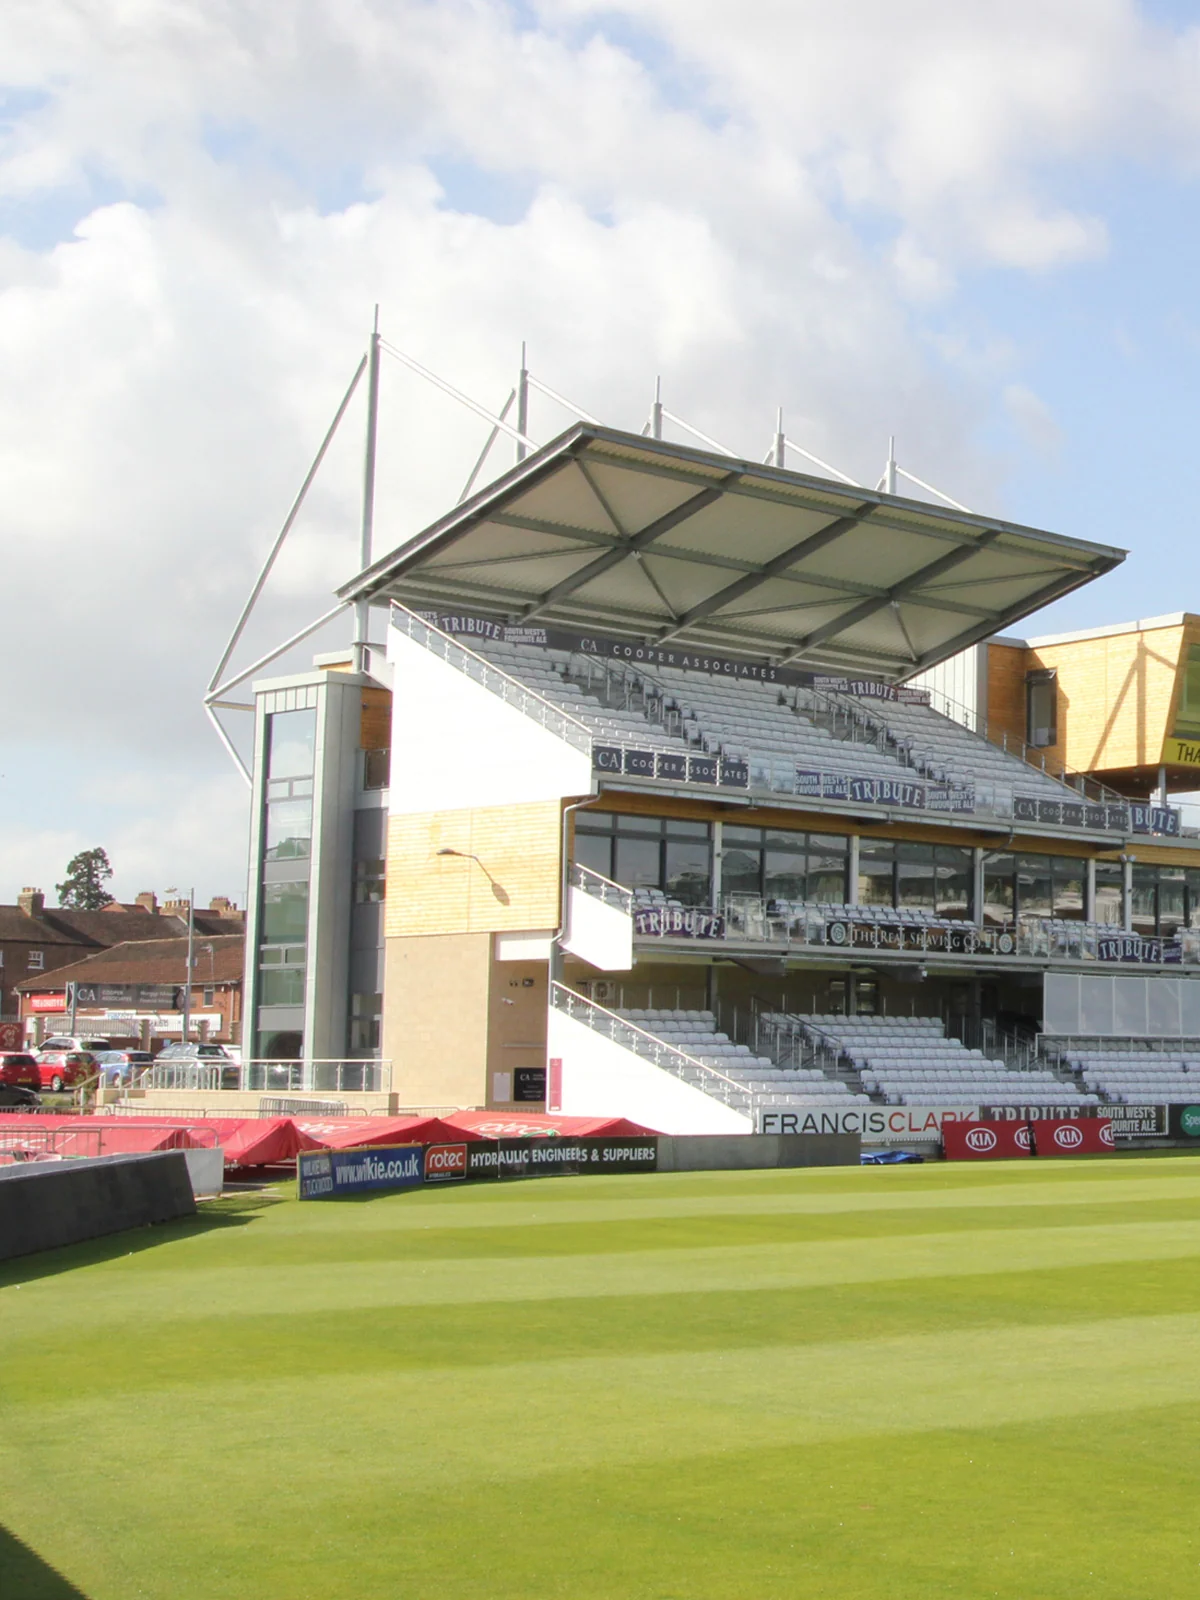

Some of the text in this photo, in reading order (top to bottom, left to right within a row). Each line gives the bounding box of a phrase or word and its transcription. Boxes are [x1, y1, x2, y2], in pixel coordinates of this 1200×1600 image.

[442, 617, 501, 640] TRIBUTE
[580, 639, 776, 680] CA COOPER ASSOCIATES
[851, 682, 897, 701] TRIBUTE
[598, 752, 619, 768] CA
[632, 759, 676, 771] COOPER
[852, 781, 922, 807] TRIBUTE
[1018, 803, 1034, 816] CA
[637, 911, 720, 938] TRIBUTE
[1100, 940, 1158, 962] TRIBUTE
[1097, 1106, 1124, 1118] SOUTH
[1126, 1106, 1156, 1118] WEST'S
[1141, 1119, 1156, 1132] ALE
[971, 1133, 992, 1146] KIA
[1058, 1130, 1079, 1143] KIA
[429, 1147, 656, 1168] rotec HYDRAULIC ENGINEERS & SUPPLIERS
